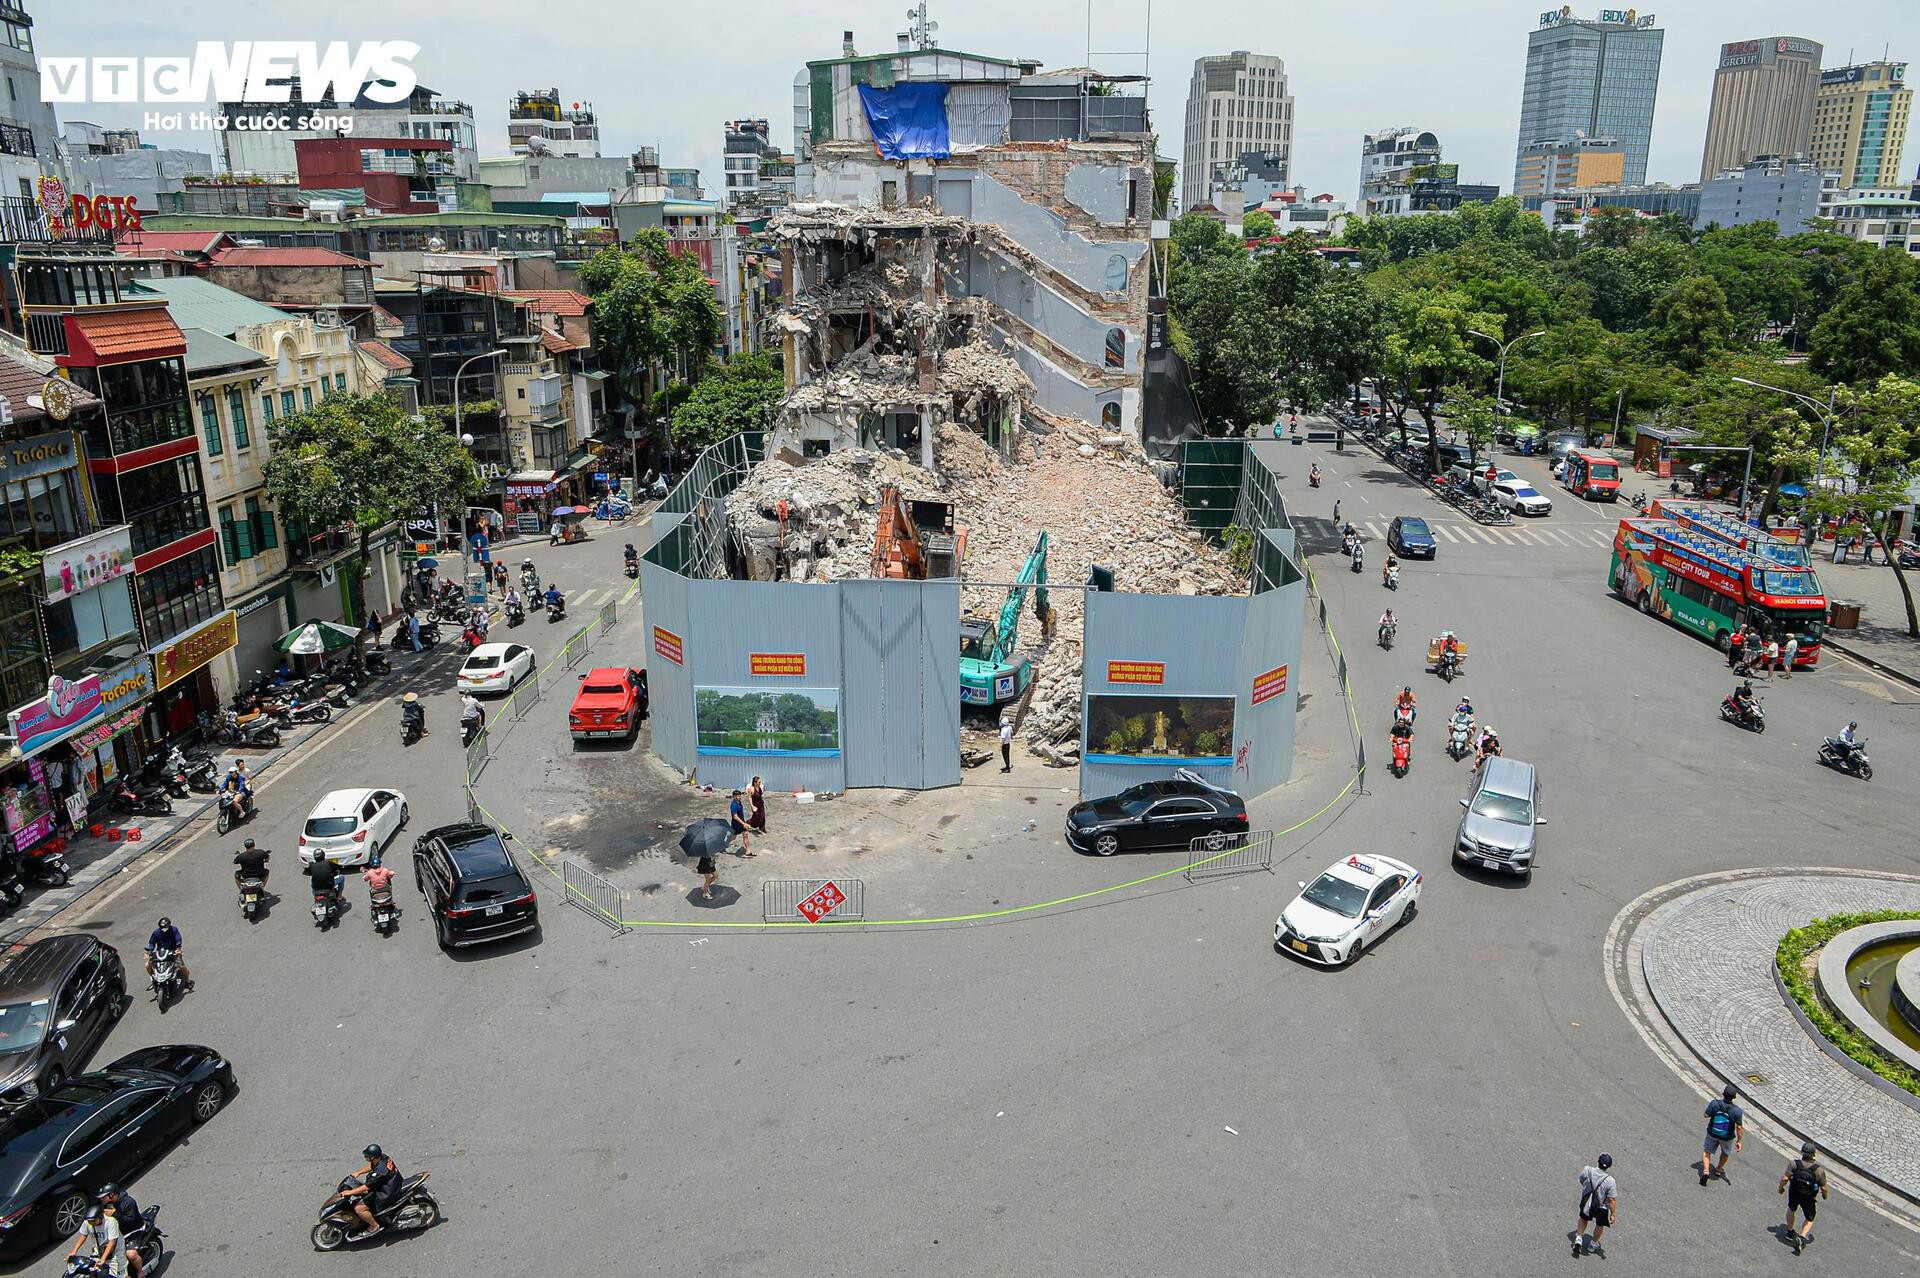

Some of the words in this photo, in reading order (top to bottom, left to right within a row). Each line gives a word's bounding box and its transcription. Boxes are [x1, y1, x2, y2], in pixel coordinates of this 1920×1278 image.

[1540, 9, 1561, 24] BIDV
[1602, 10, 1627, 22] BIDV
[1722, 55, 1758, 67] GROUP
[71, 193, 141, 231] DGTS
[507, 486, 515, 494] SIM
[522, 486, 532, 494] FREE
[533, 486, 544, 494] DATA
[408, 520, 434, 529] SPA
[1663, 553, 1681, 567] HANOI
[1681, 562, 1694, 572] CITY
[1695, 567, 1711, 579] TOUR
[236, 595, 269, 618] Vietcombank
